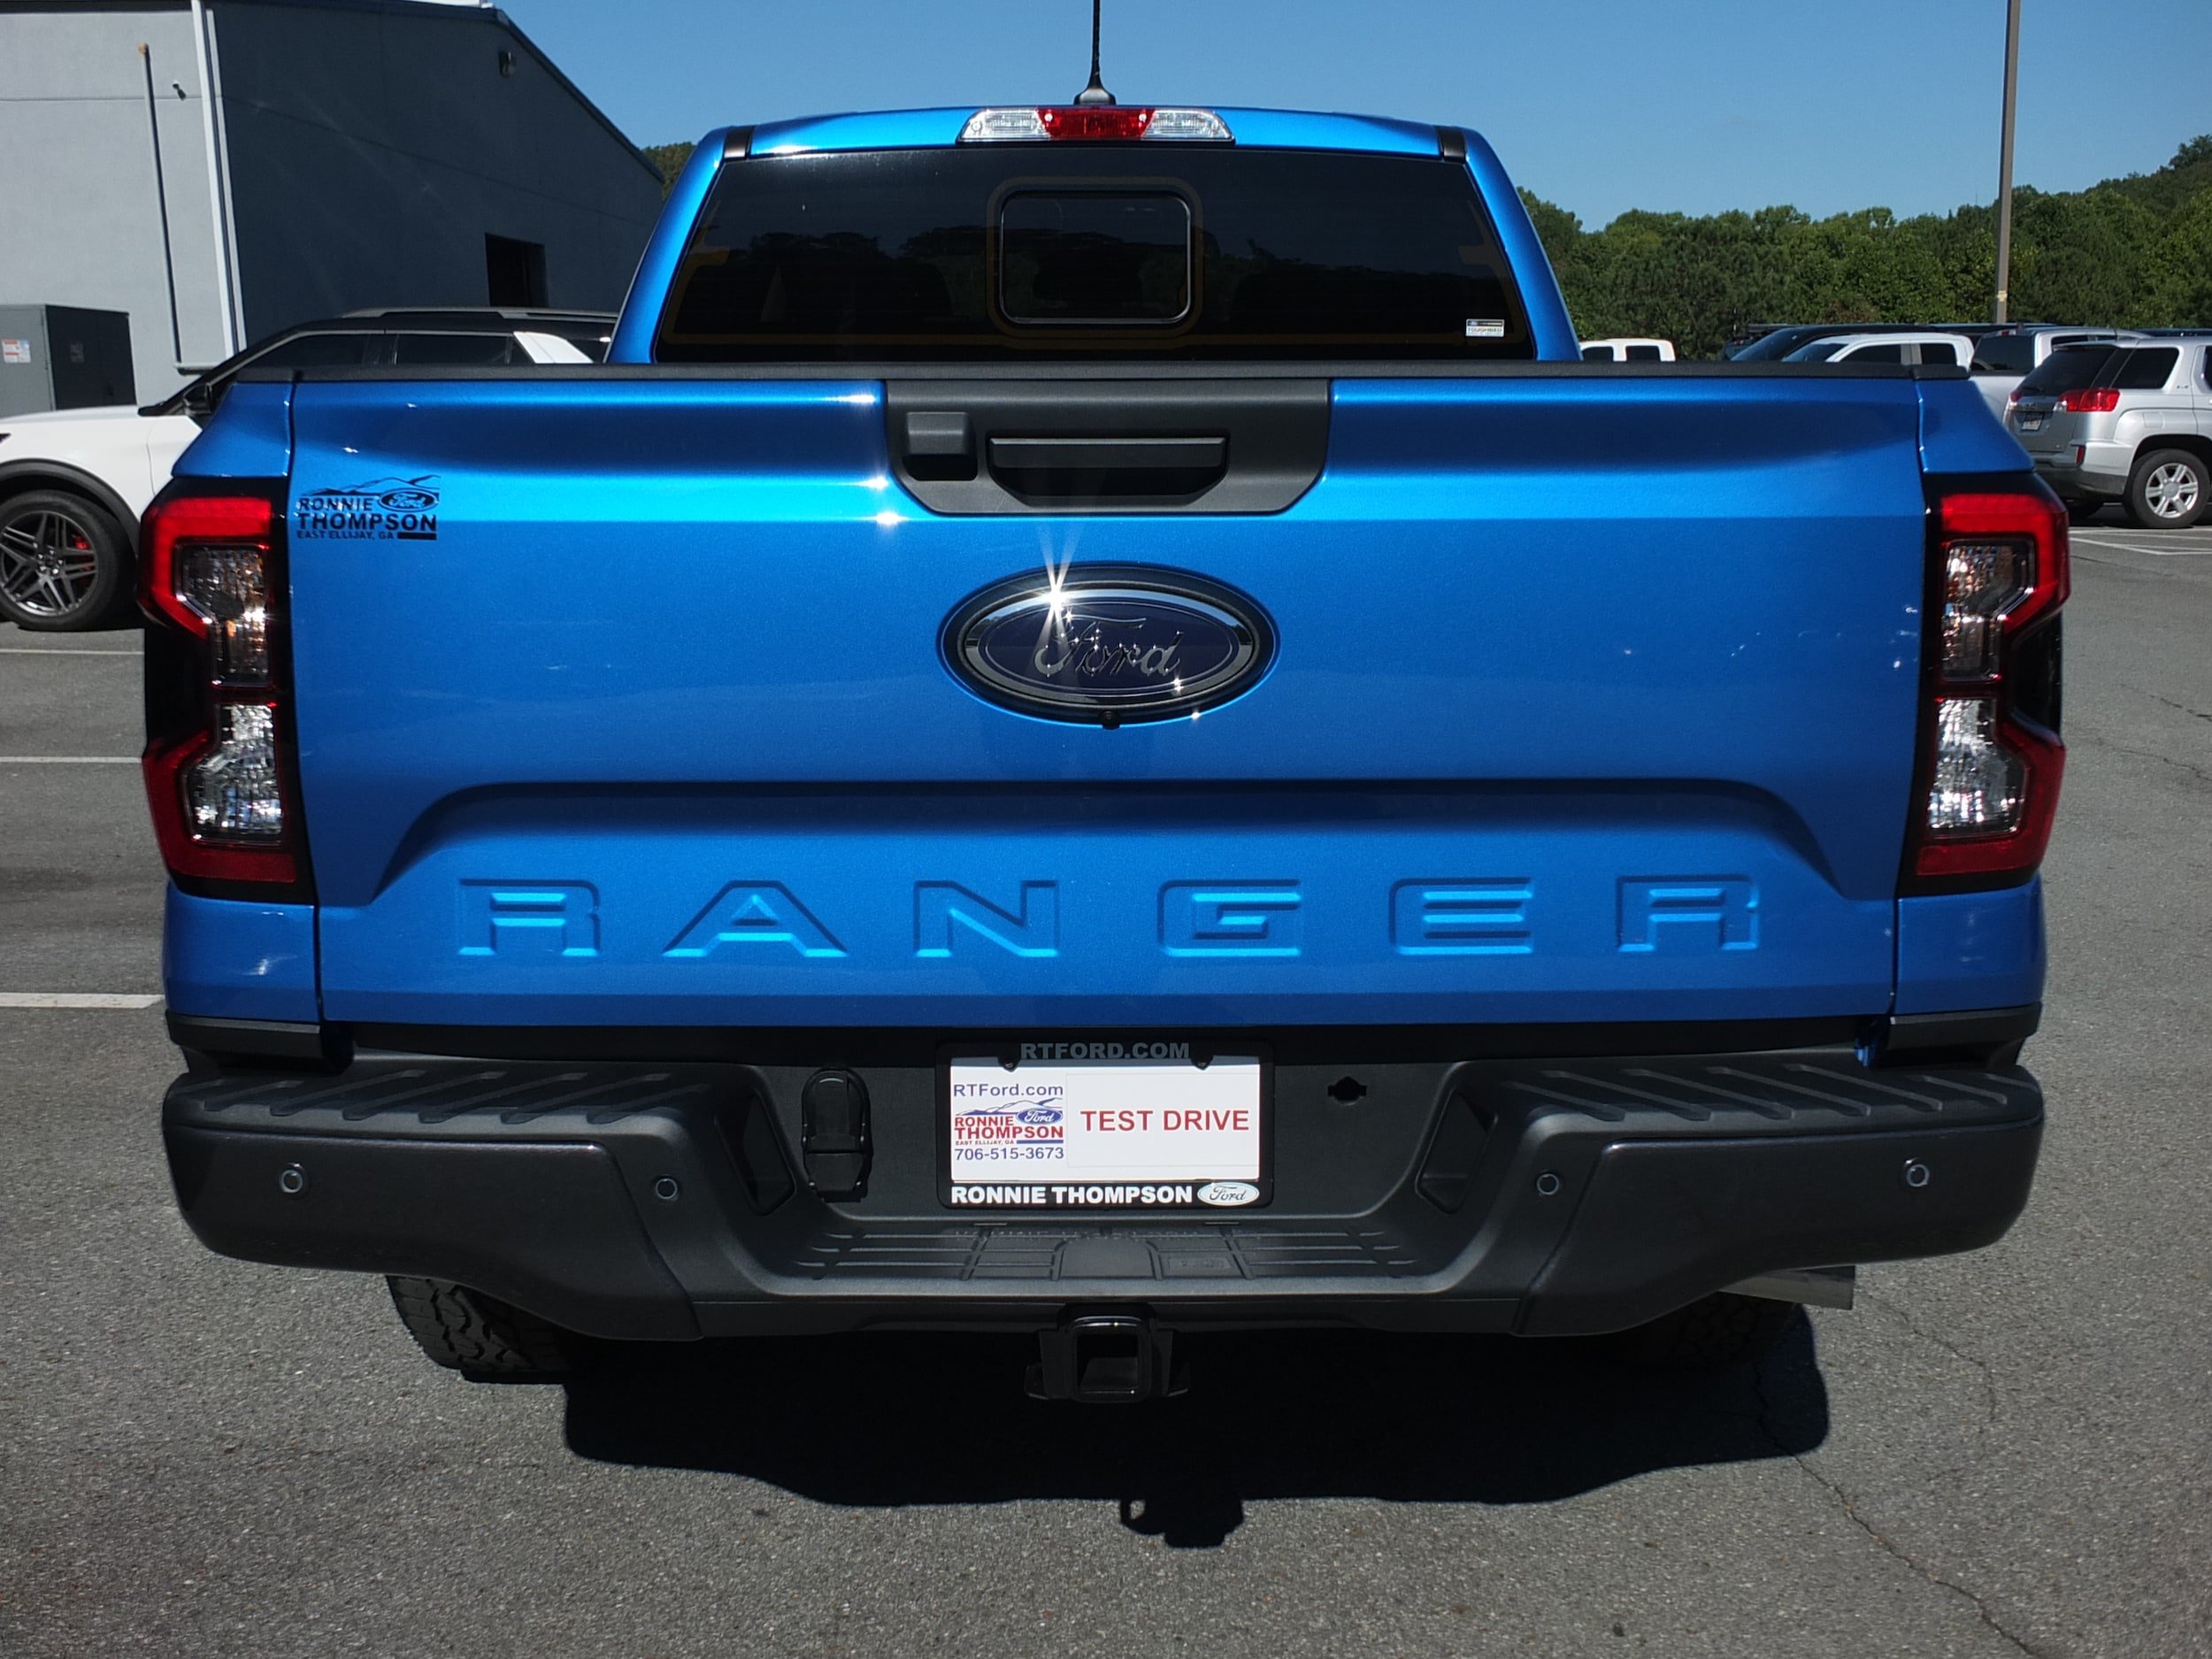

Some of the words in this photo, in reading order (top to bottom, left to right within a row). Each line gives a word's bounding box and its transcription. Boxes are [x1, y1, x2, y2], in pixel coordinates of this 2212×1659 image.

[299, 497, 373, 511] RONNIE
[298, 512, 437, 532] THOMPSON
[1033, 614, 1184, 678] Ford
[458, 874, 1761, 957] RANGER
[1020, 1042, 1190, 1059] RTFORD.COM
[953, 1083, 1064, 1097] RTFord.com
[955, 1116, 1014, 1126] RONNIE
[1080, 1110, 1154, 1132] TEST
[1164, 1110, 1250, 1132] DRIVE
[954, 1125, 1064, 1140] THOMPSON
[955, 1147, 1064, 1161] 706-515-3673
[951, 1185, 1047, 1205] RONNIE
[1051, 1186, 1193, 1204] THOMPSON
